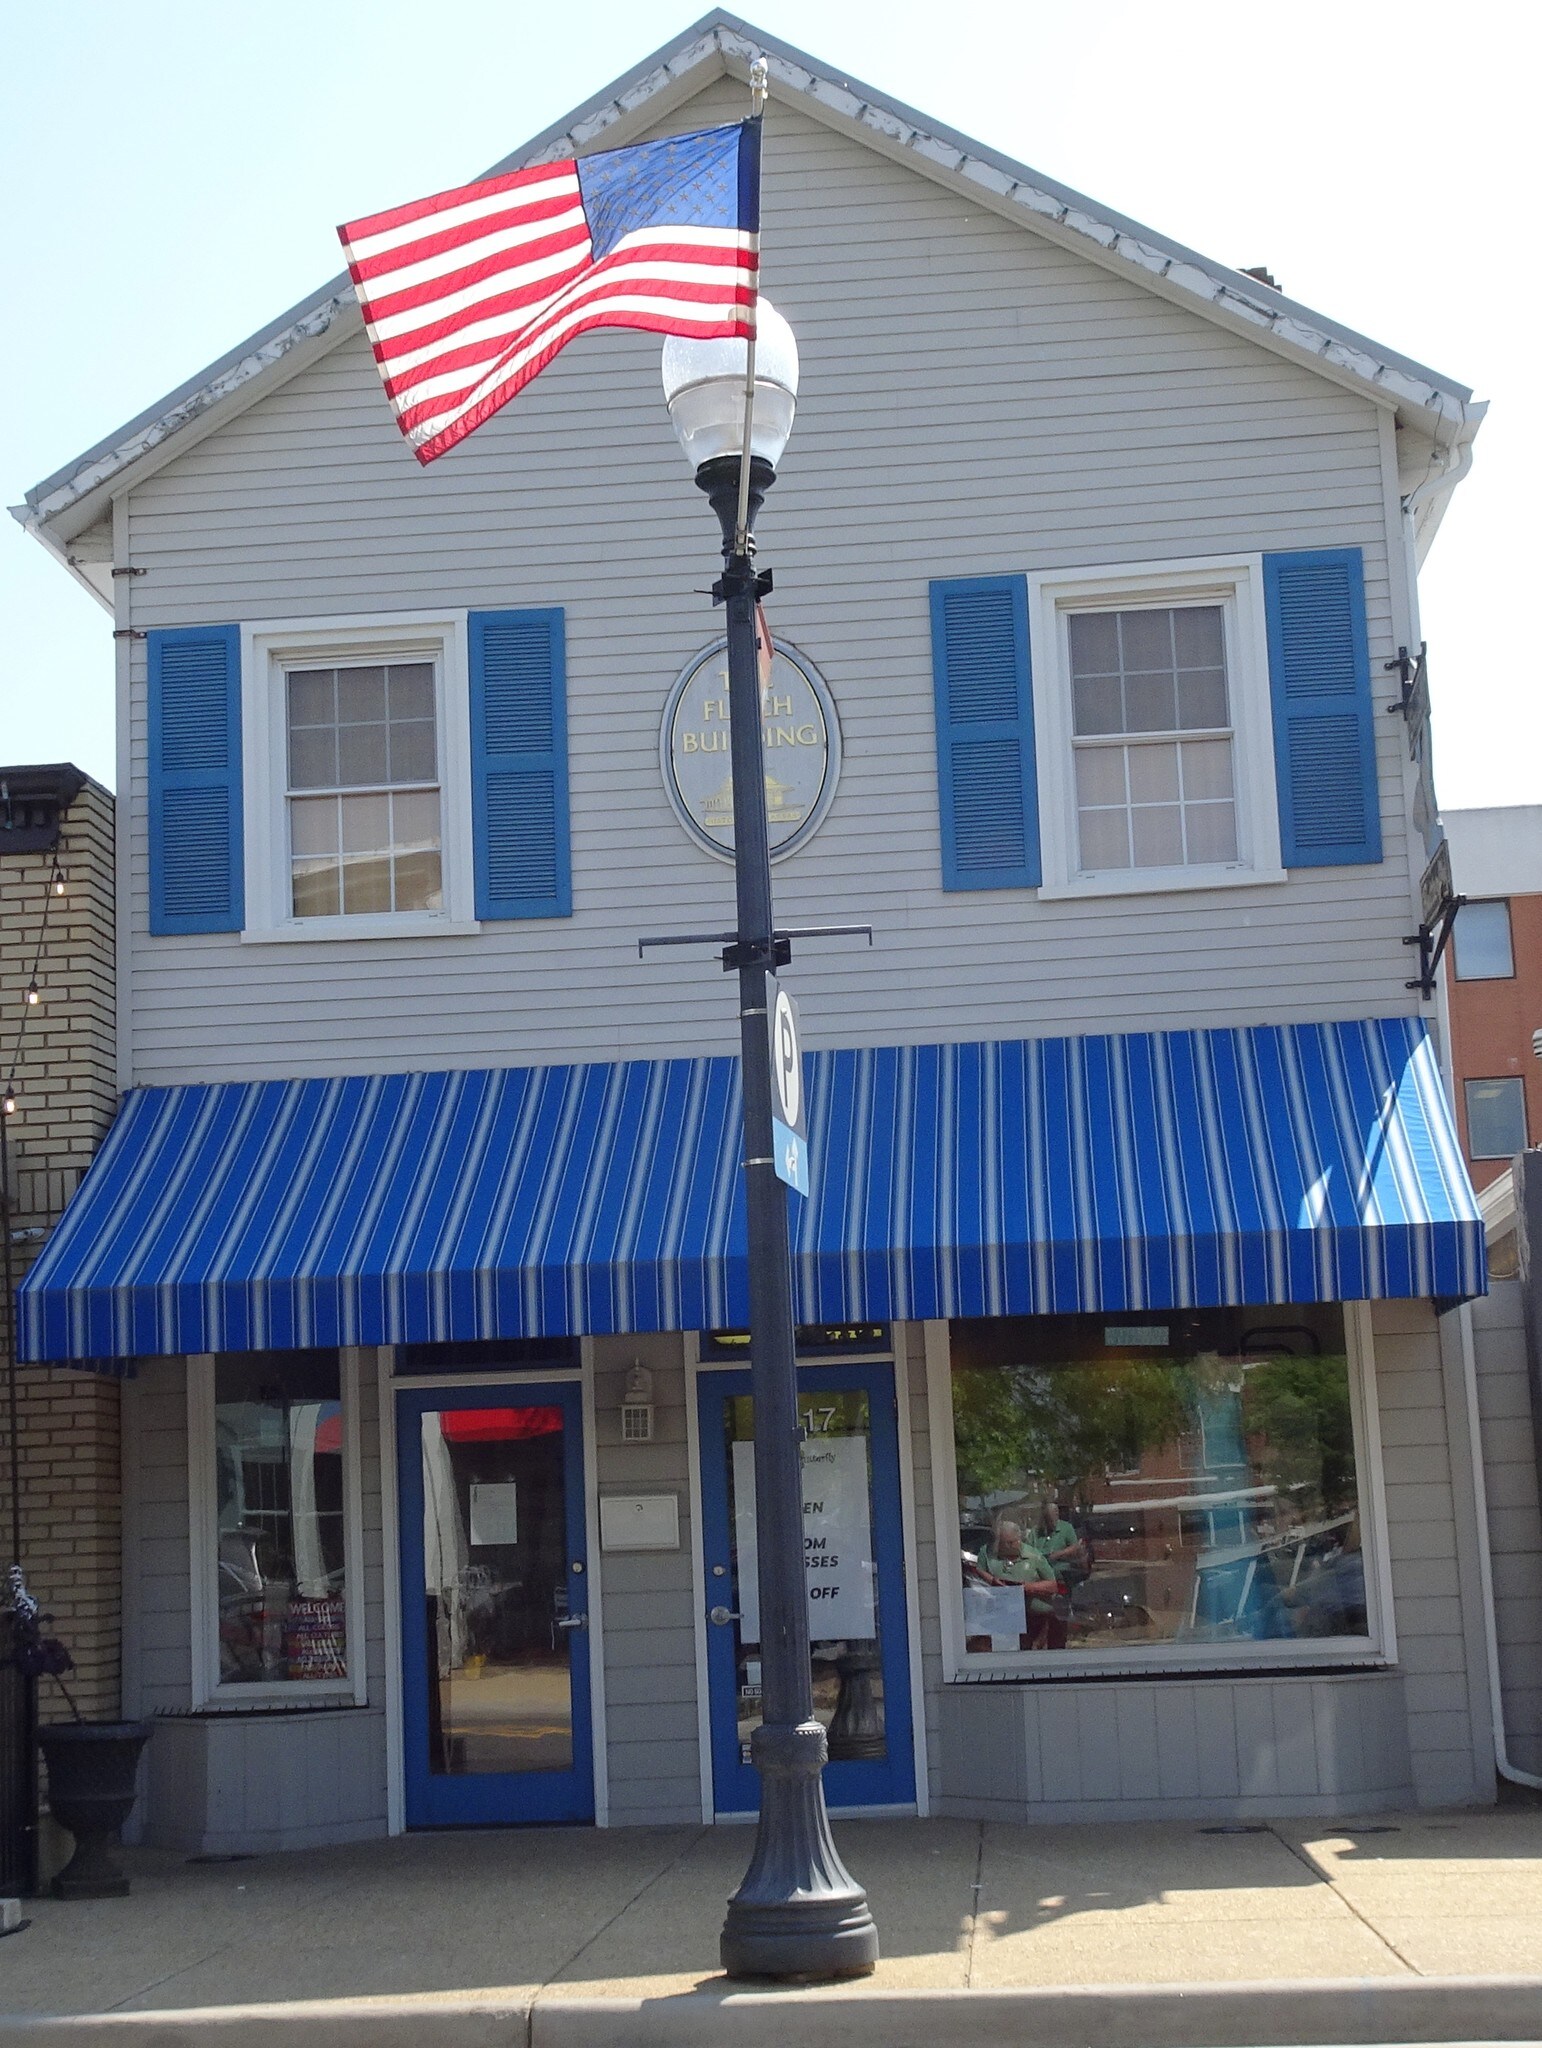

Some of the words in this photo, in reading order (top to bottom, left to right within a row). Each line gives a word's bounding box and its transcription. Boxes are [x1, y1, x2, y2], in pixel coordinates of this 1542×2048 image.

[682, 724, 818, 752] BUIING
[780, 1009, 793, 1108] P
[810, 1587, 840, 1600] OFF
[290, 1602, 345, 1615] WELCOME
